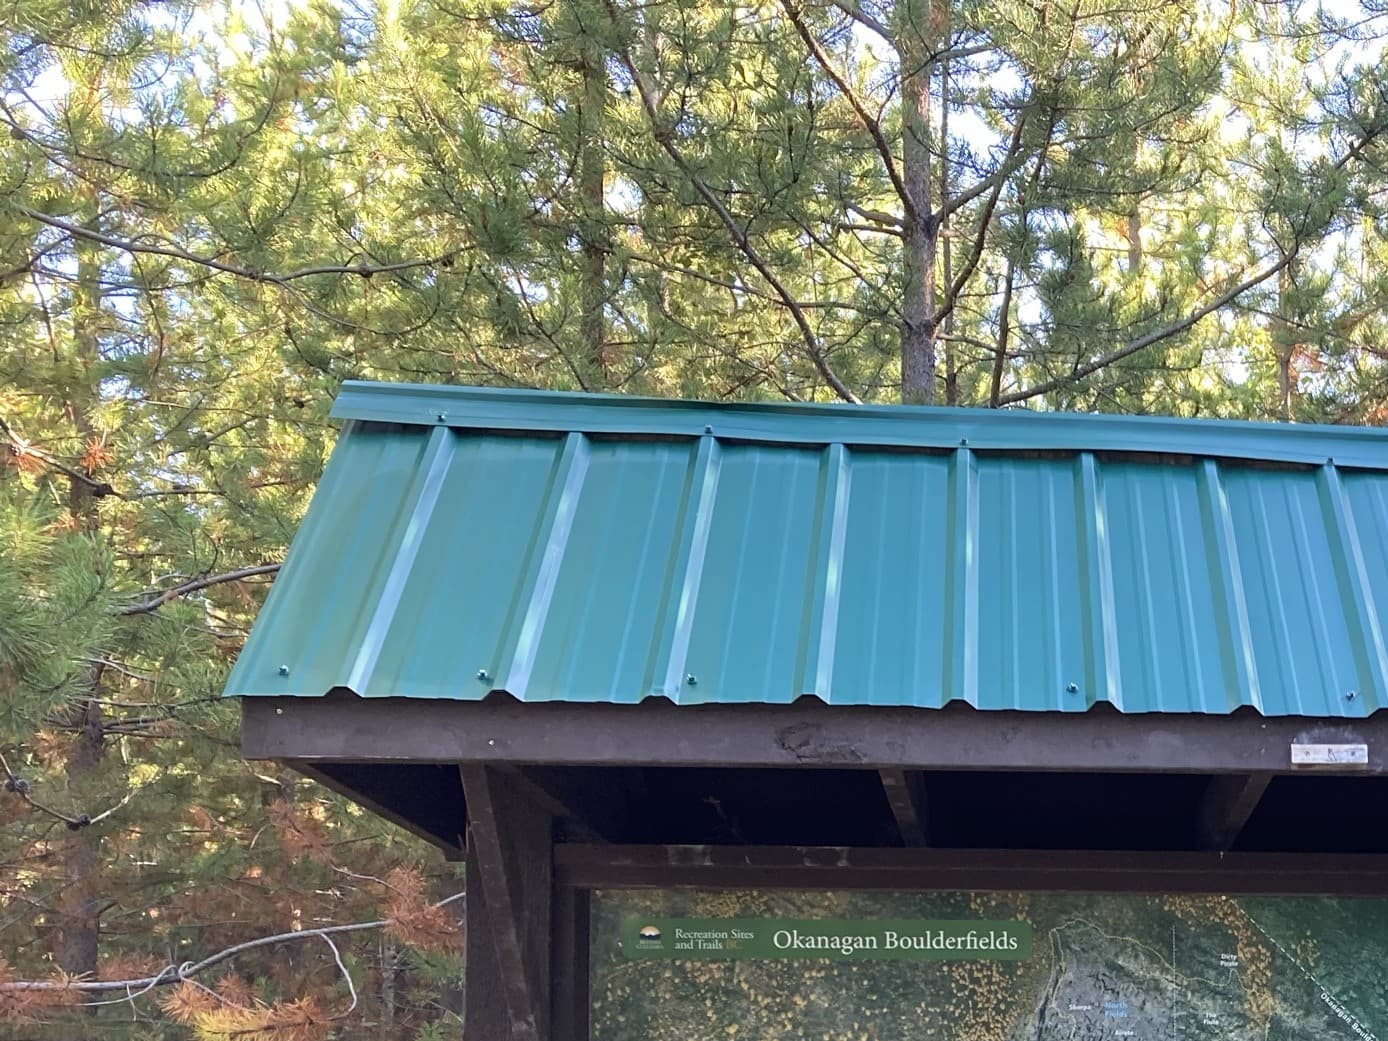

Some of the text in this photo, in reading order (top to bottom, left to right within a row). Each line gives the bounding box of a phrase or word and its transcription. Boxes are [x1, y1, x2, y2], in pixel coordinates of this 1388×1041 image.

[675, 928, 754, 939] Recreation Sites
[773, 930, 1018, 955] Okanagan Boulderfields
[674, 939, 694, 949] and
[697, 939, 723, 949] Trails
[1320, 992, 1351, 1024] Okanagan
